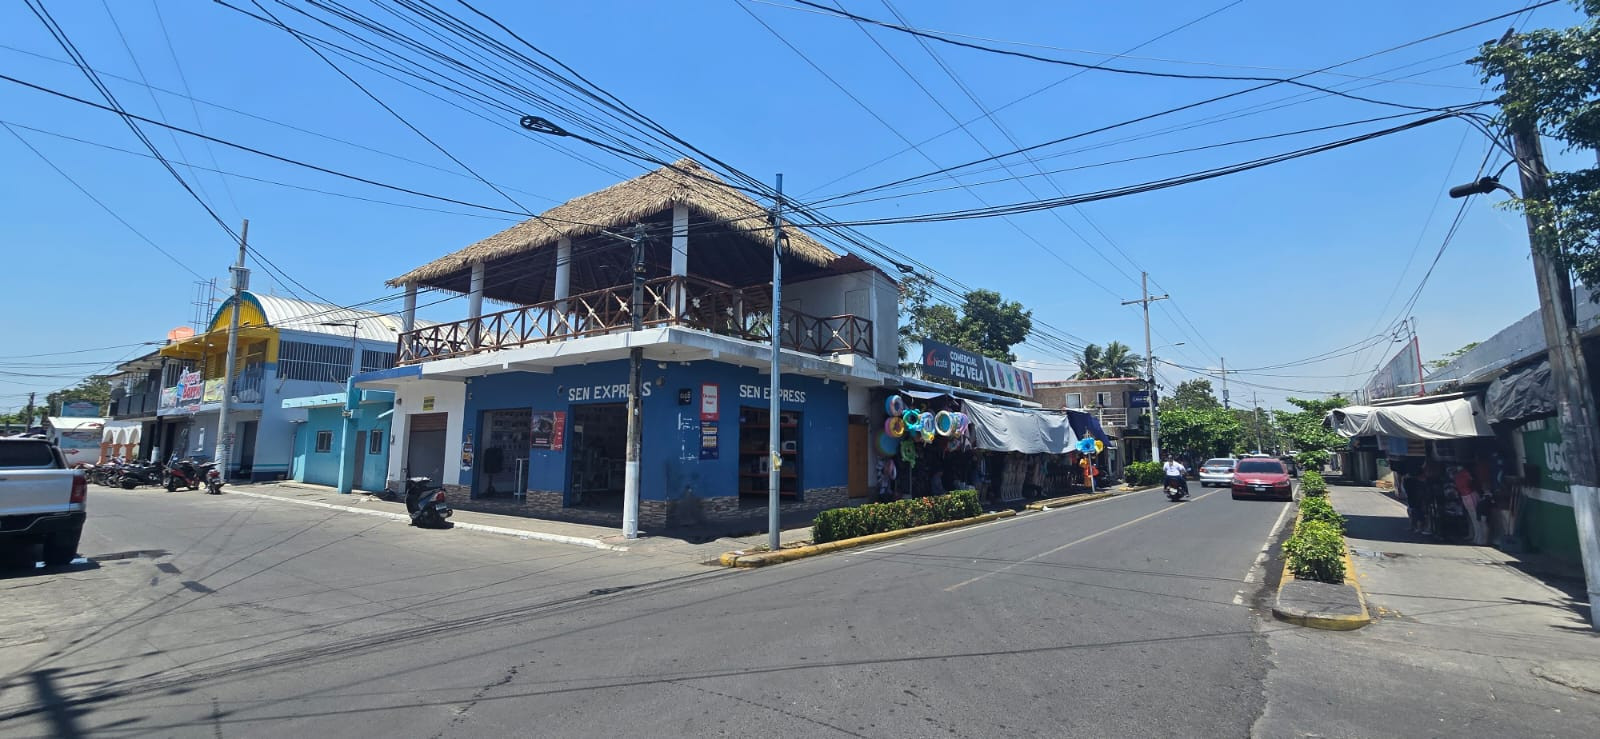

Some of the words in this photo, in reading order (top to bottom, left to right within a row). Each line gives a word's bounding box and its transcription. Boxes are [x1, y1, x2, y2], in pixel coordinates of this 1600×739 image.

[949, 351, 978, 367] COMERCIAL
[950, 362, 966, 378] PEZ
[966, 365, 985, 383] VELA
[568, 386, 590, 401] SEN
[739, 384, 761, 399] SEN
[763, 387, 807, 403] EPRESS
